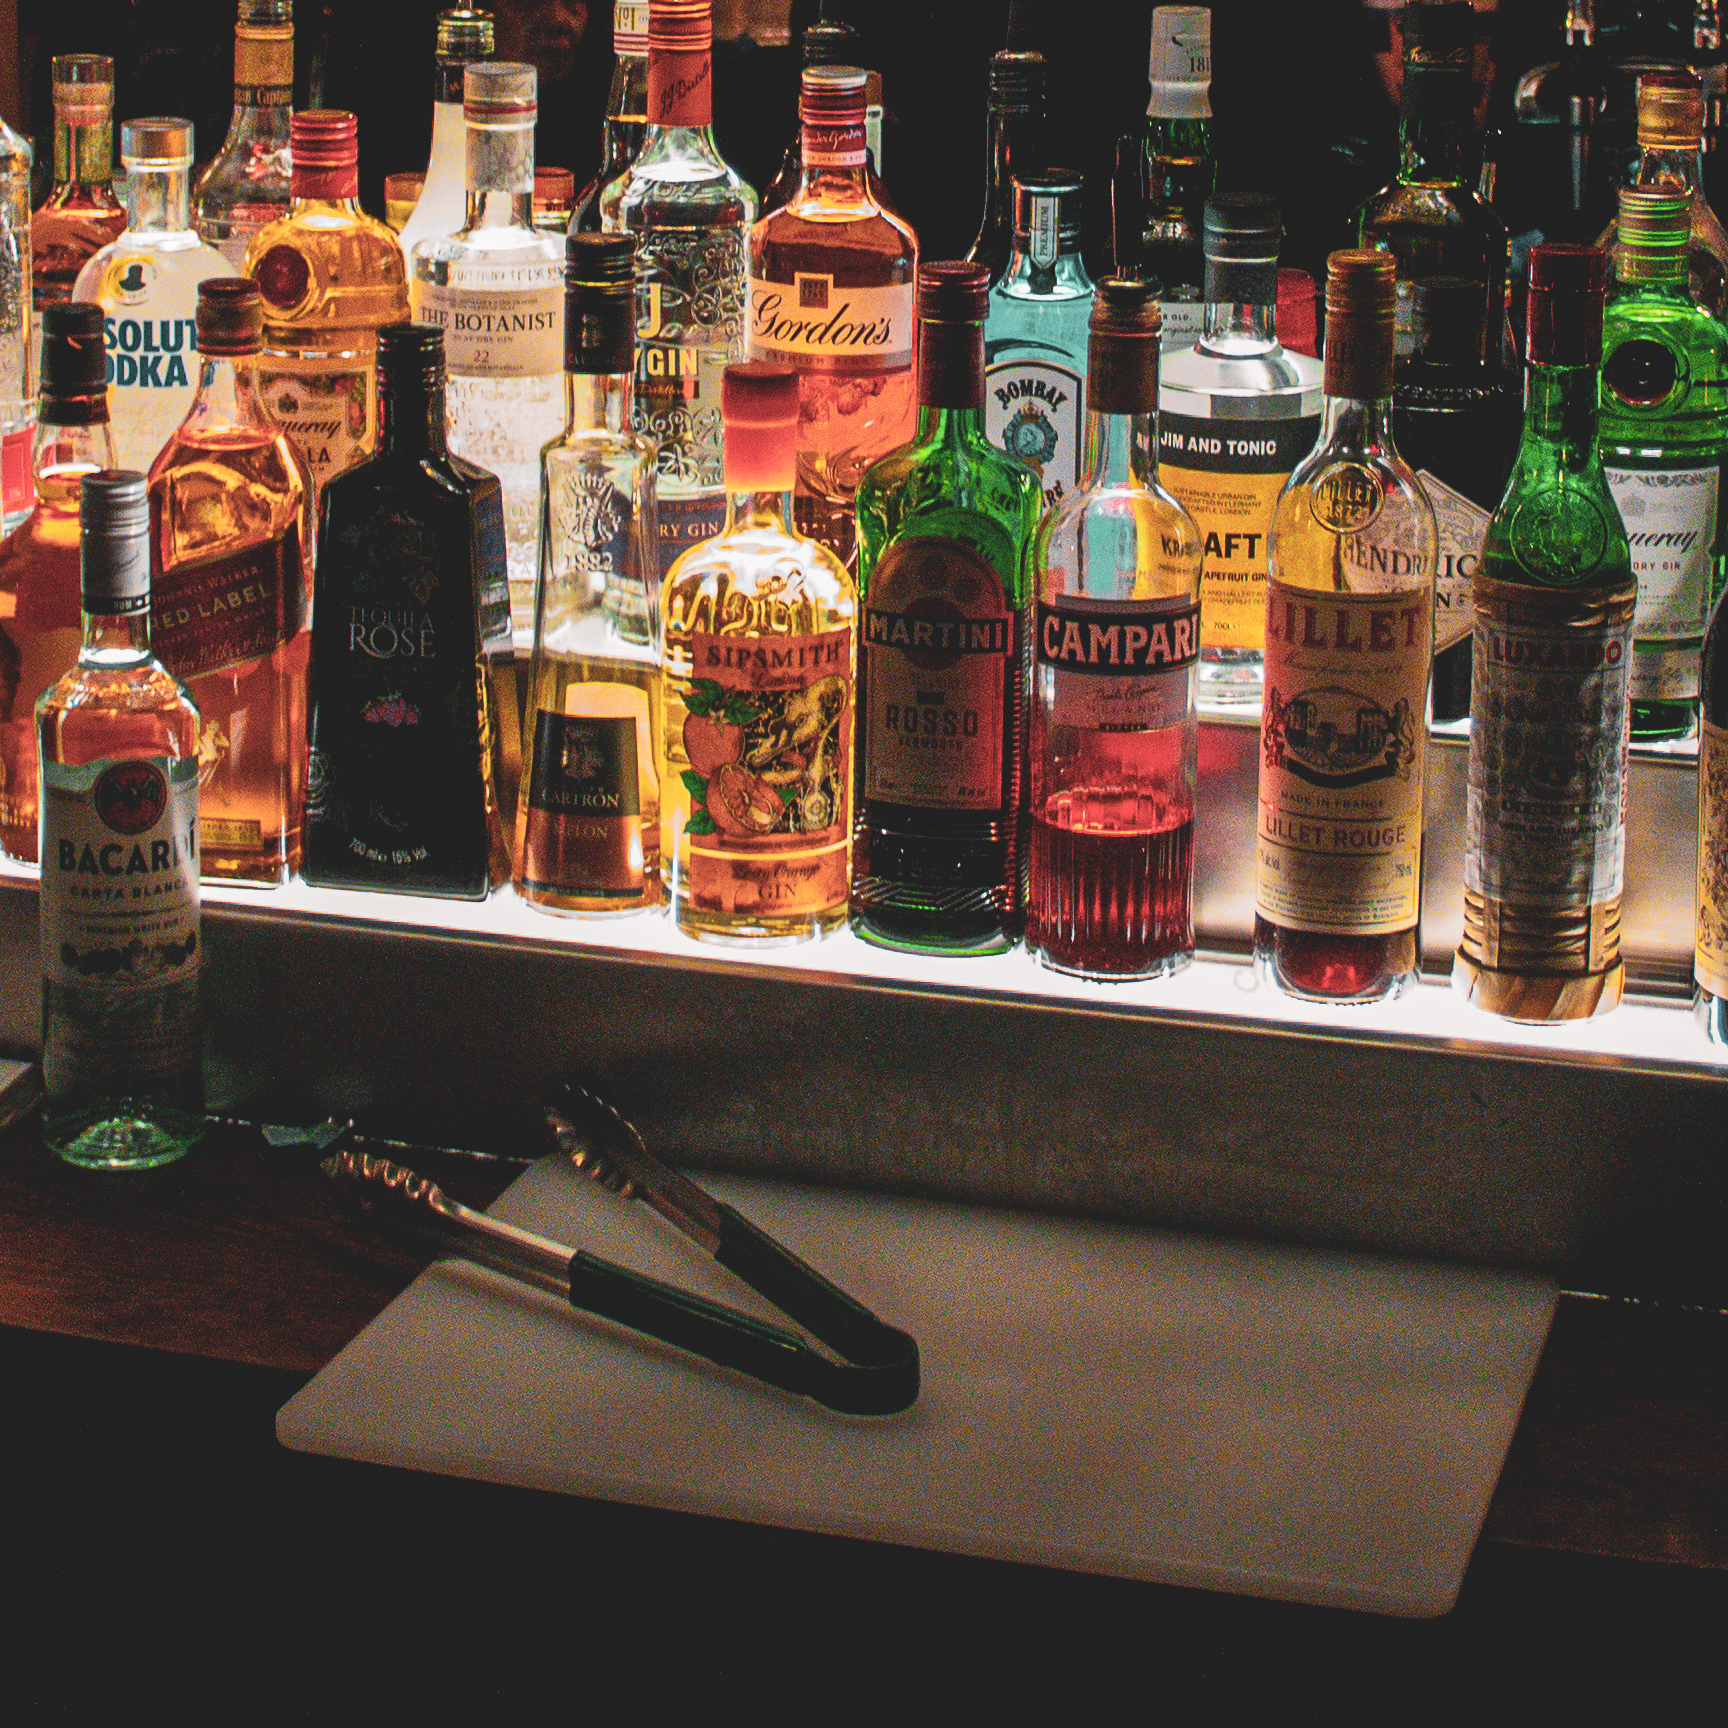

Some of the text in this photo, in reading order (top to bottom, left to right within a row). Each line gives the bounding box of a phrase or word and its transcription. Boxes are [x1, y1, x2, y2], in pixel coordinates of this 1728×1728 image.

[1038, 205, 1049, 259] PREMIUM
[103, 317, 198, 354] SOLUT
[454, 310, 557, 332] BOTANIST
[750, 290, 894, 347] Gordon's
[473, 349, 490, 363] 22
[647, 349, 698, 375] GIN
[993, 377, 1068, 413] BOMBAY
[1160, 430, 1277, 456] JIM AND TONIC
[658, 521, 719, 538] RY GIN
[1204, 570, 1250, 583] APEFRUIT
[196, 581, 273, 619] LABEL
[348, 622, 436, 659] ROSE
[871, 614, 1005, 652] MARTINI
[1042, 611, 1199, 667] CAMPARI
[1268, 602, 1422, 652] LILLET
[706, 641, 840, 670] SIPSMITH
[885, 703, 978, 737] ROSSO
[1281, 791, 1311, 807] MADE
[1334, 798, 1386, 809] FRANCE
[1265, 813, 1406, 849] LILLET ROUGE
[70, 884, 124, 899] CARTA
